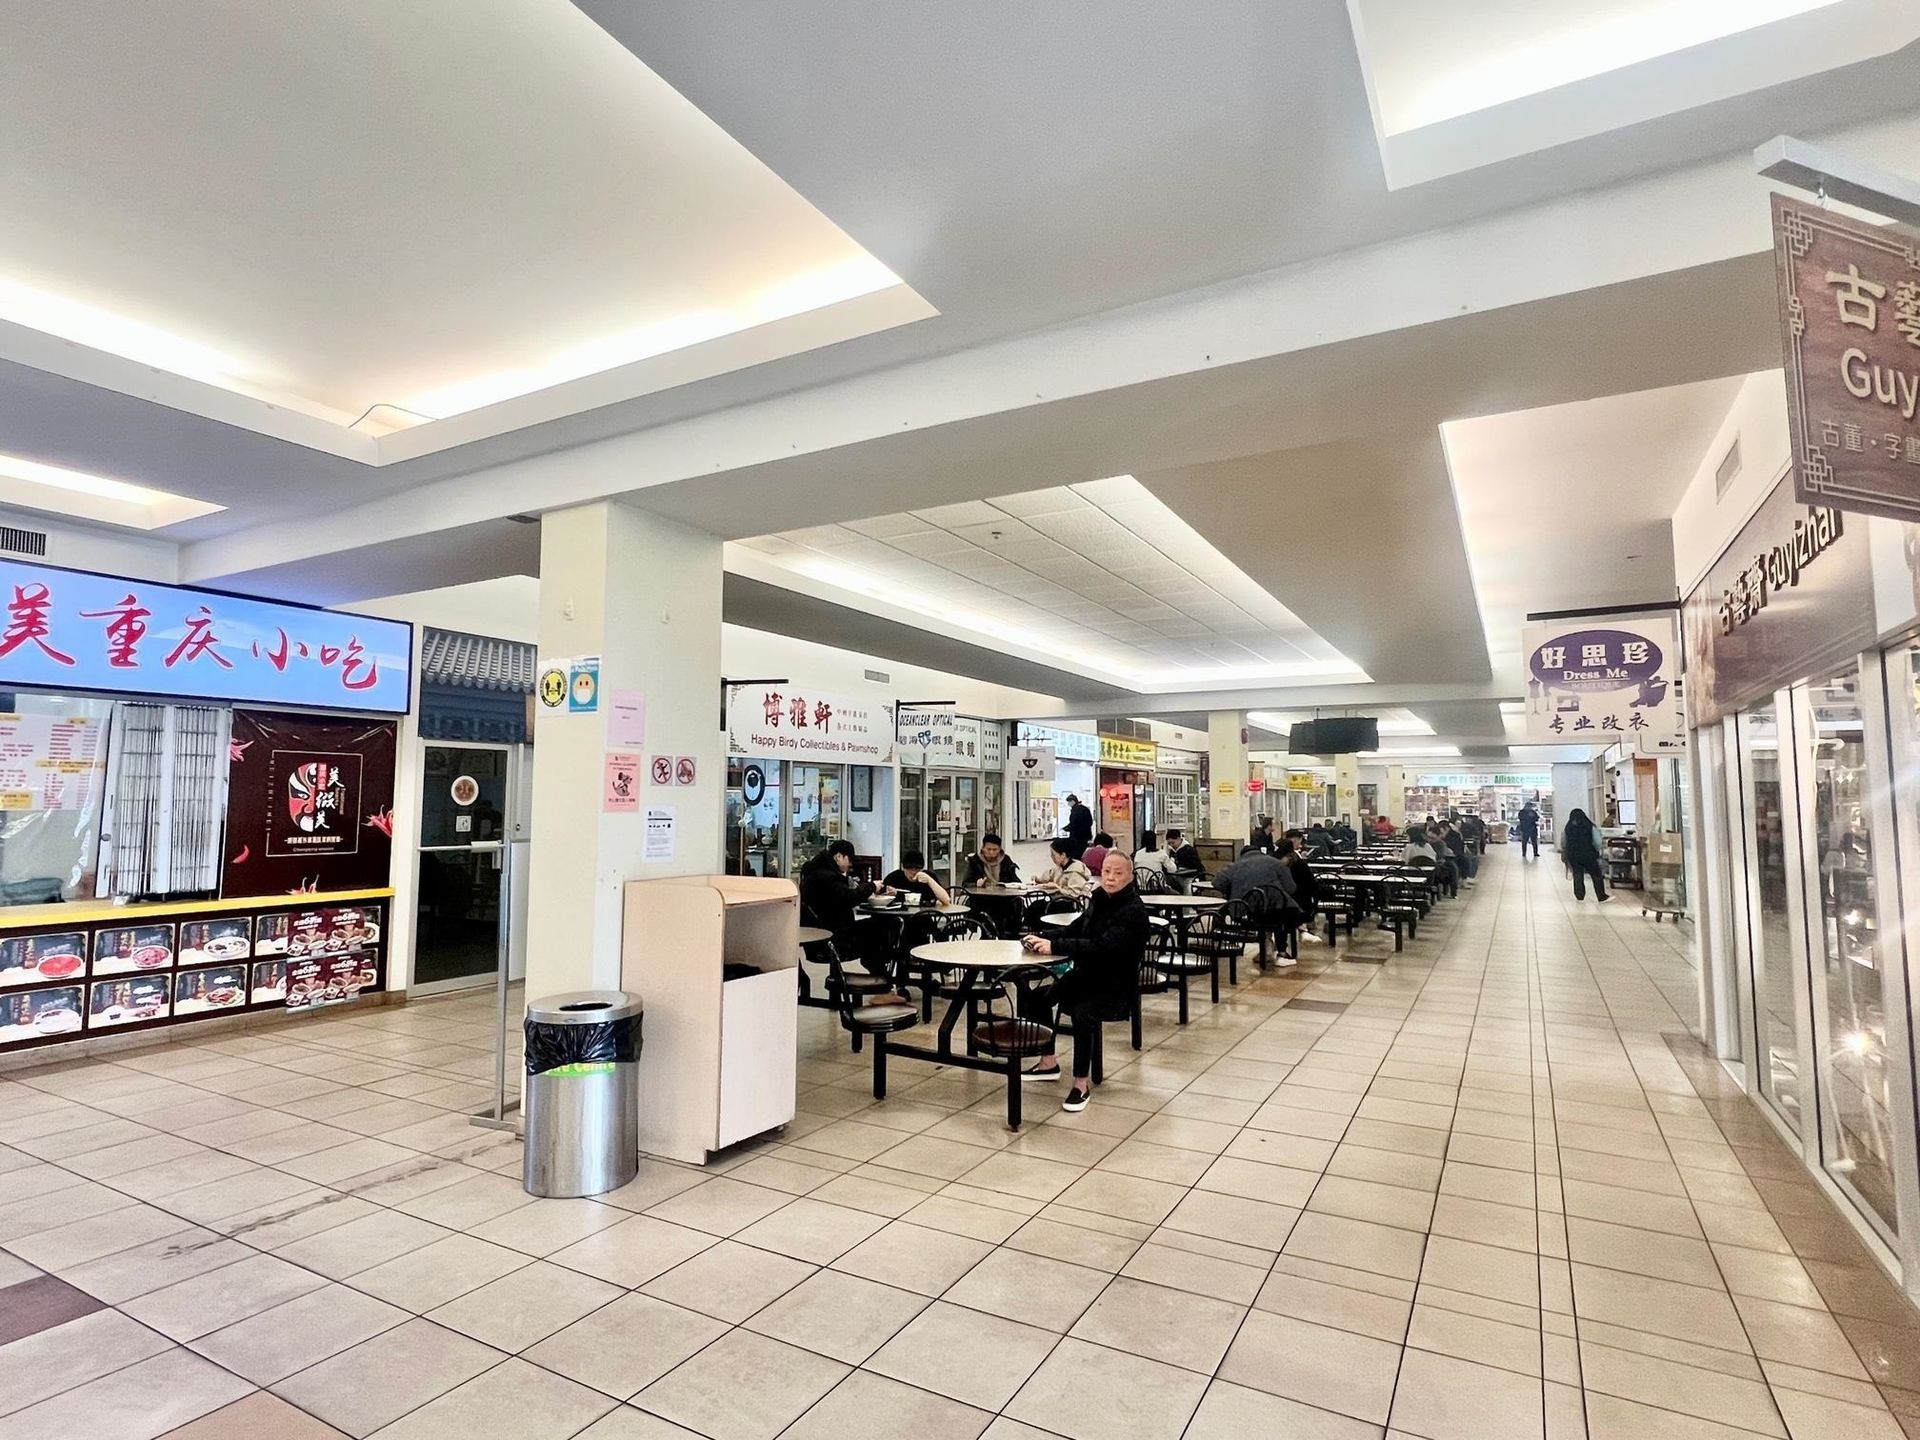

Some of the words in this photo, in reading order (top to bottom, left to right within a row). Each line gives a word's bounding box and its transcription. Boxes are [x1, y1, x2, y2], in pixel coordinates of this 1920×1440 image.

[1563, 670, 1600, 680] Dress
[1605, 668, 1629, 679] Me
[900, 714, 930, 726] OCEANCLEAR
[933, 714, 953, 726] OPTICAL
[1549, 712, 1649, 734] 专业改衣
[751, 734, 777, 748] Happy
[780, 736, 798, 750] Birdy
[800, 738, 839, 752] Collectibles
[841, 743, 846, 751] &
[848, 743, 878, 754] Pawnshop
